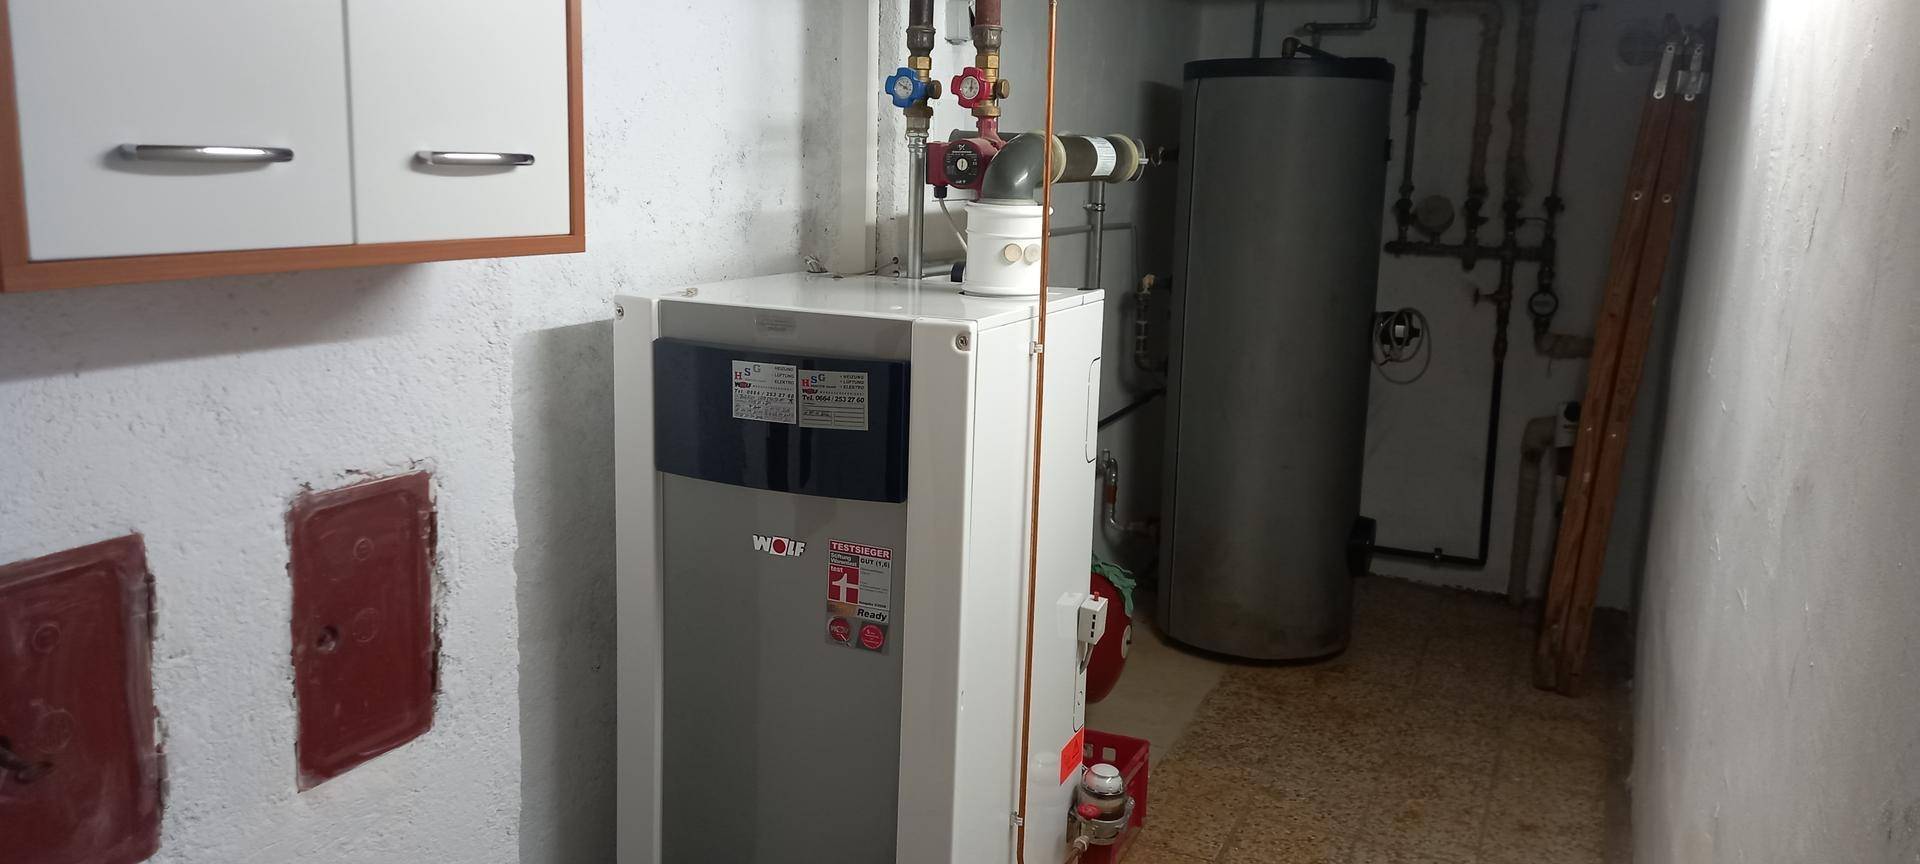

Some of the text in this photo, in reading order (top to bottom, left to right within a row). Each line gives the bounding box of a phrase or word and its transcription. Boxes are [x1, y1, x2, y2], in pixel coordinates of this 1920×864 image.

[752, 534, 807, 557] WOLF
[831, 541, 890, 559] TESTSIEGER
[857, 608, 887, 622] Ready
